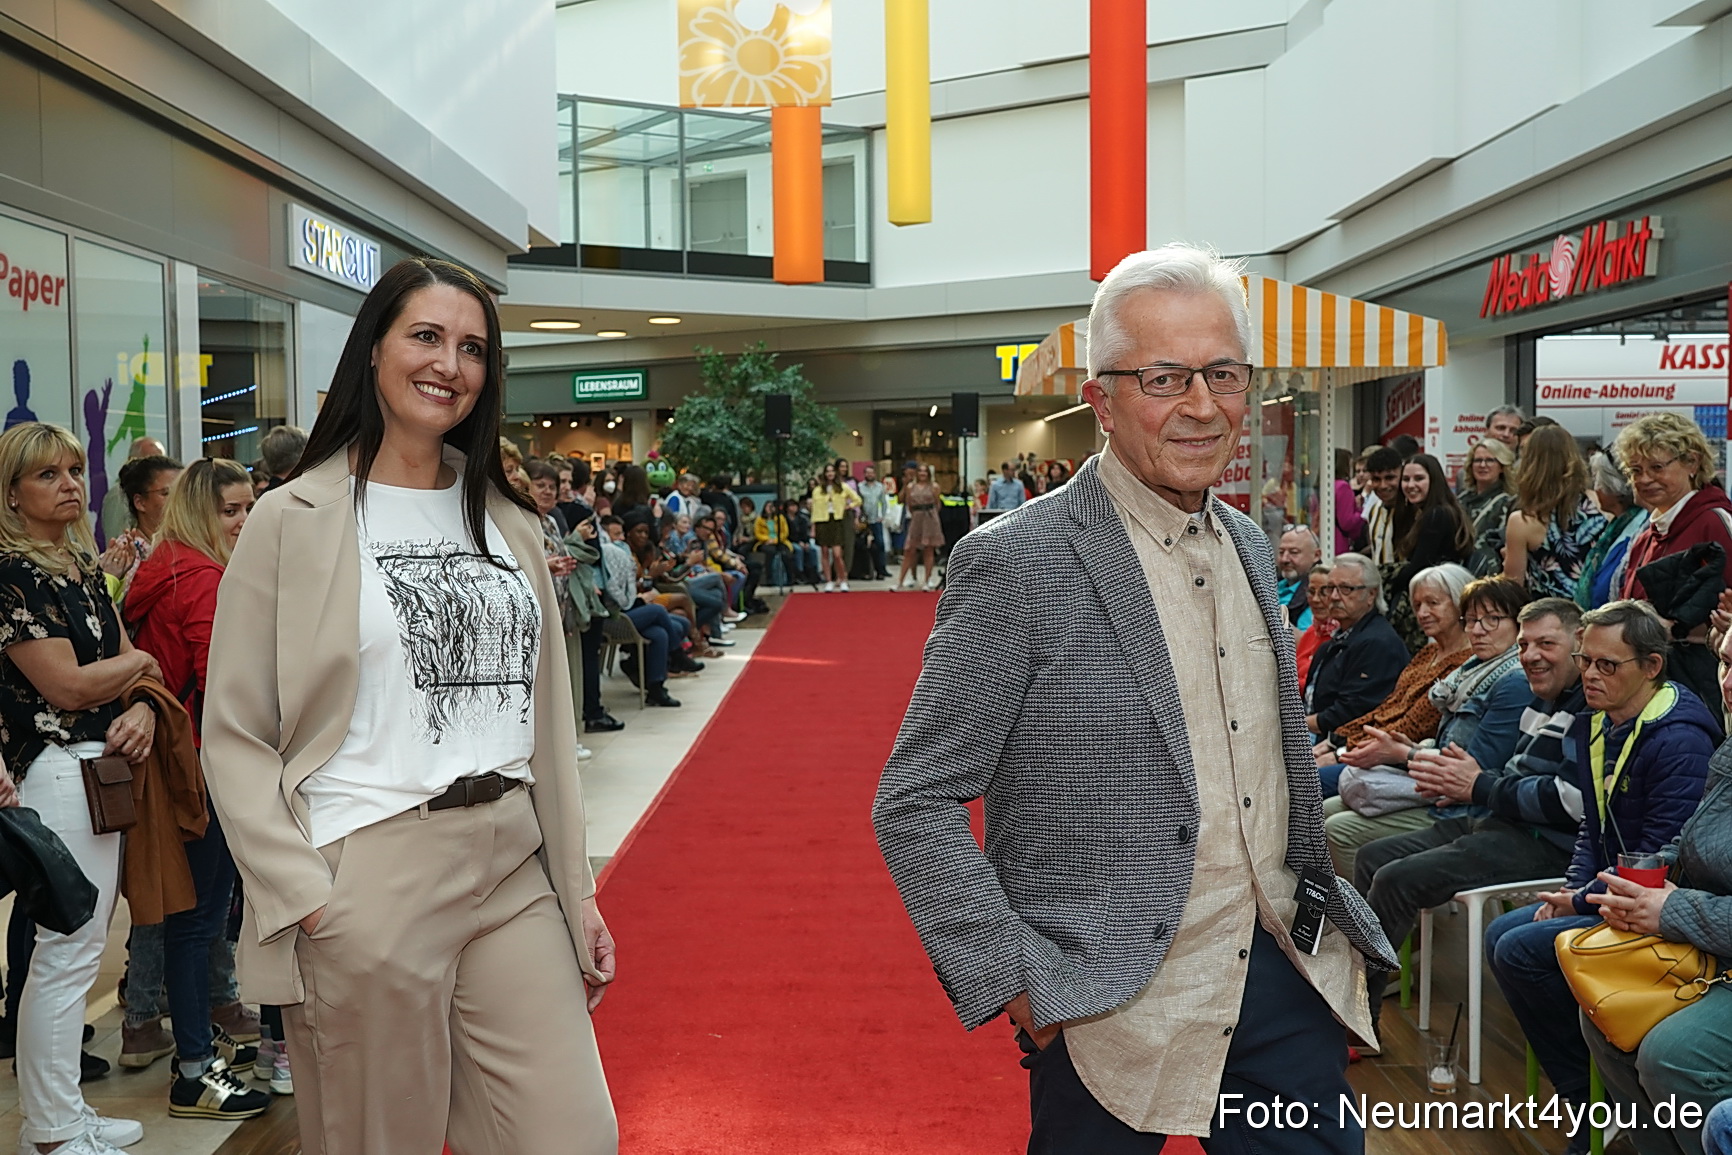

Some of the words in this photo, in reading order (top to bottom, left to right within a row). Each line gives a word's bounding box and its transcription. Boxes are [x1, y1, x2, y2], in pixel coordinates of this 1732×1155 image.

[303, 218, 378, 288] STARCUT
[1479, 253, 1551, 319] Media
[1566, 215, 1654, 296] Markt
[1659, 344, 1730, 370] KASS
[579, 379, 639, 392] LEBENSRAUM
[1541, 384, 1676, 400] Online-Abholung
[1452, 424, 1488, 433] Abholun
